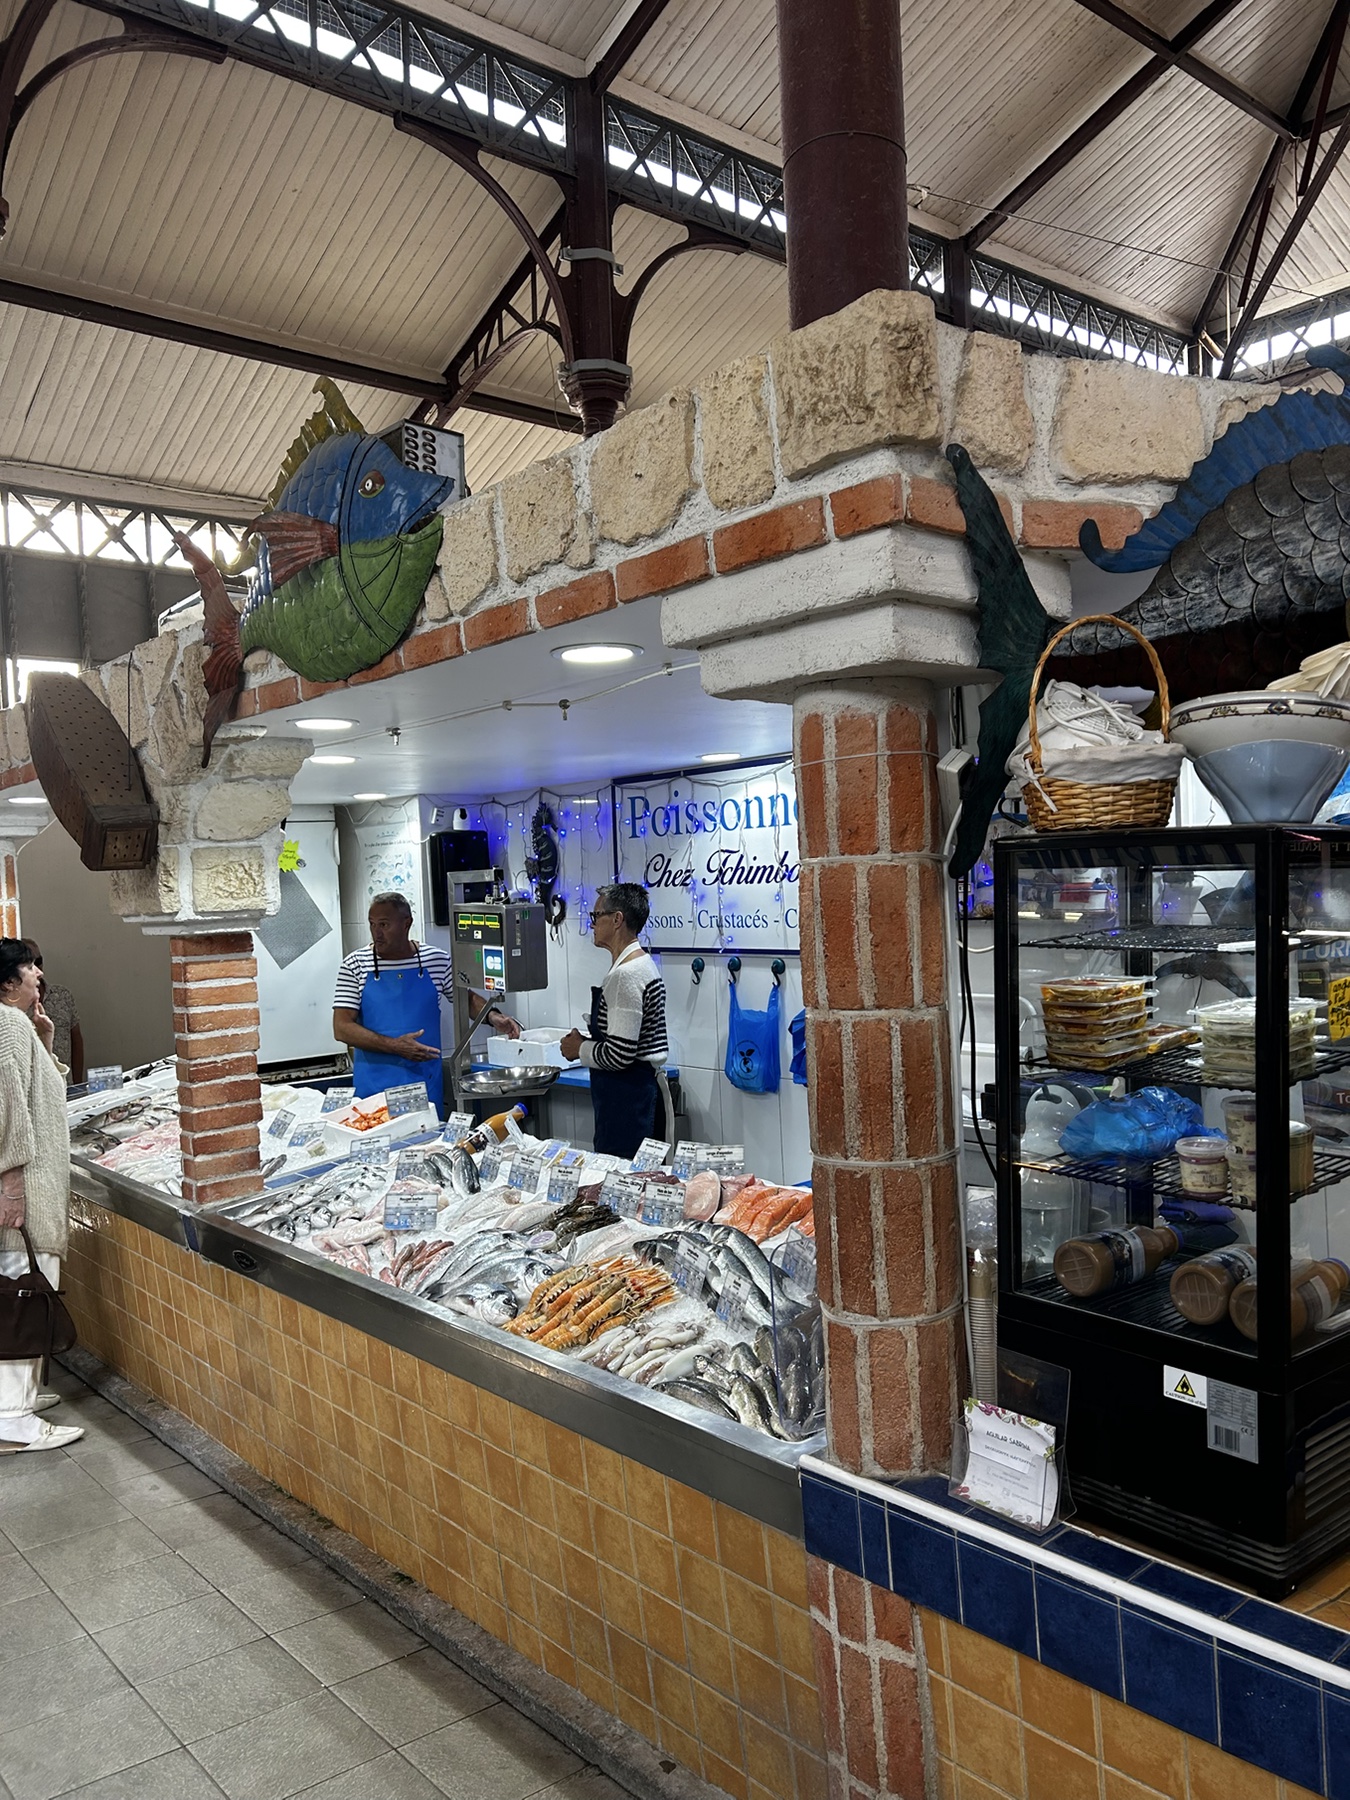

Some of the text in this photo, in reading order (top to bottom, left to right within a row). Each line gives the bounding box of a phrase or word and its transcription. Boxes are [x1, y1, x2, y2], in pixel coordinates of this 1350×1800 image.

[627, 790, 798, 839] Poissonn
[645, 853, 695, 888] Chez
[647, 914, 684, 929] ssons
[697, 909, 769, 929] Crustacés
